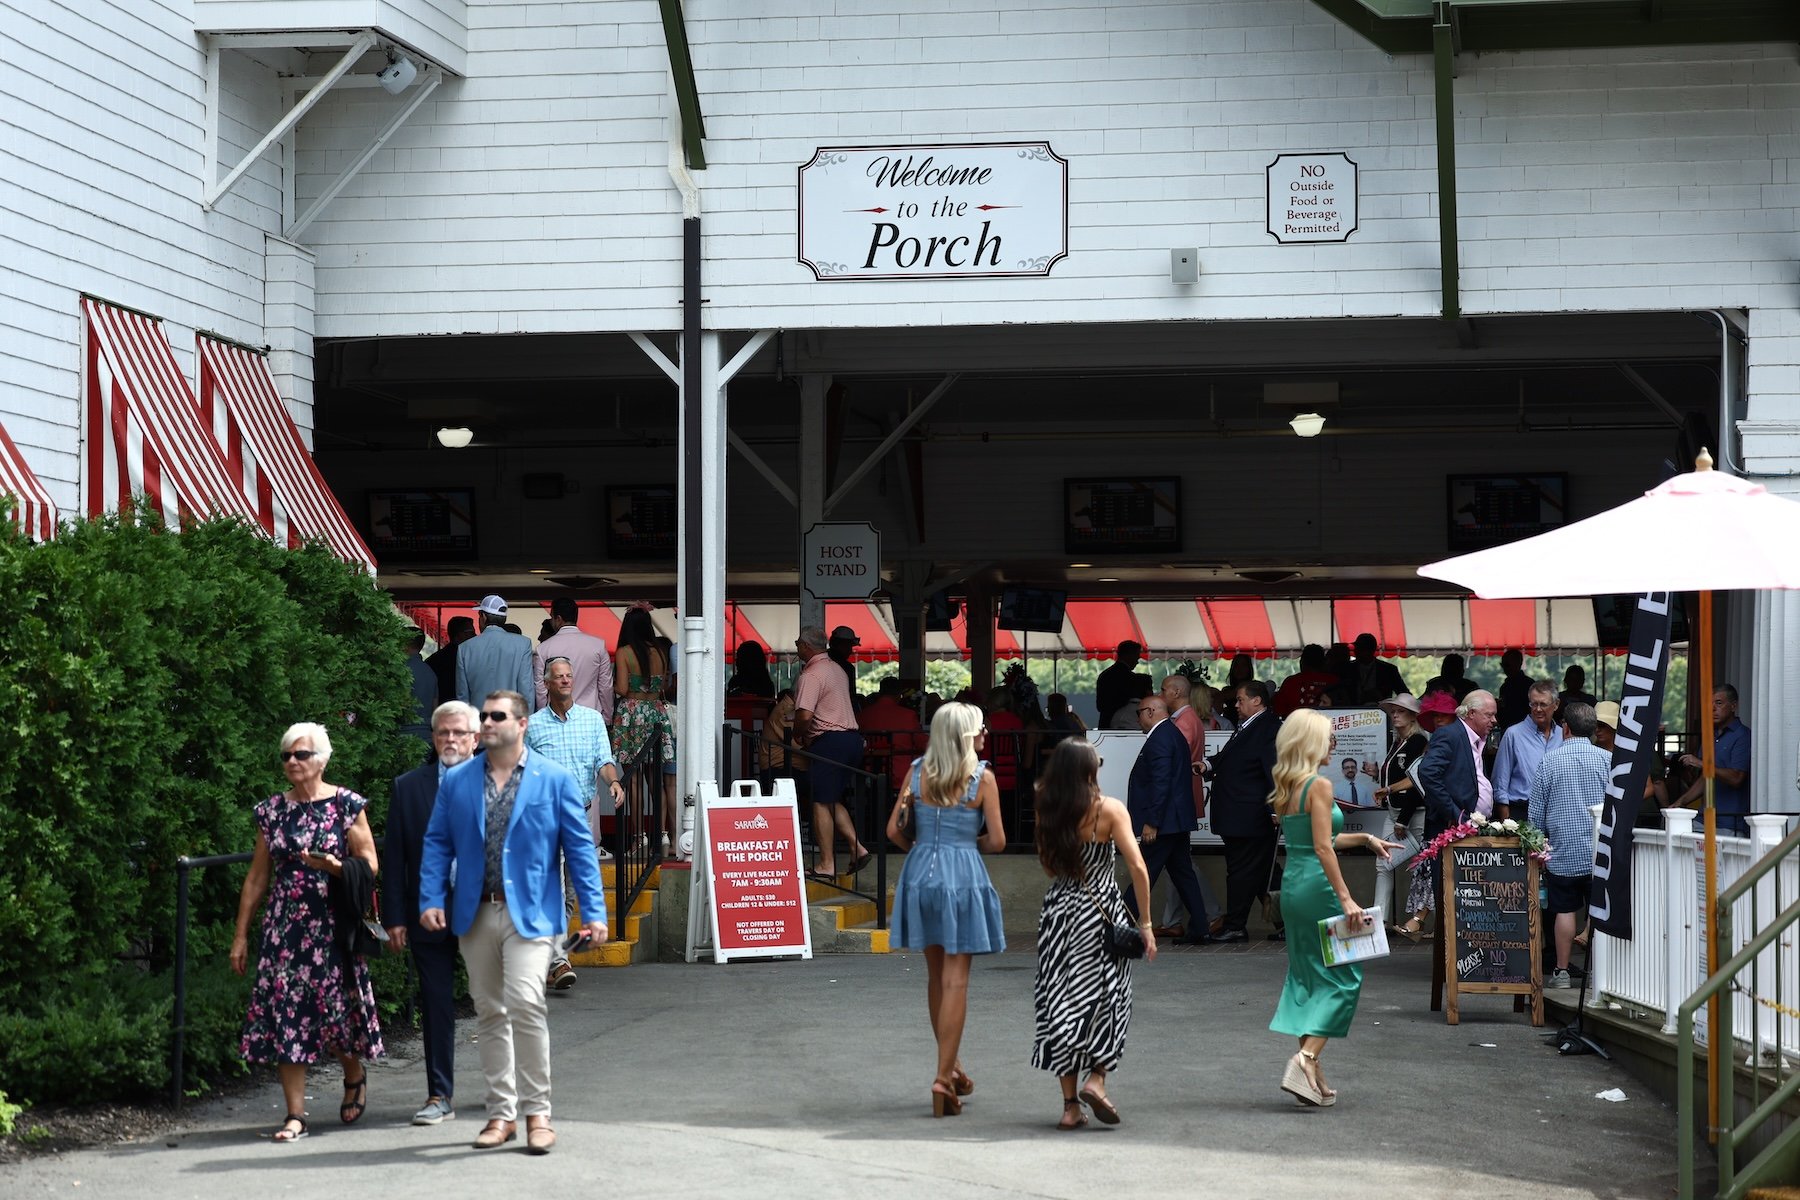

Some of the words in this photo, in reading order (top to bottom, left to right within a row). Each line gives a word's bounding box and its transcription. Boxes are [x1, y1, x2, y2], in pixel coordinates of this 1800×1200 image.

[866, 155, 993, 188] Welcome
[1300, 165, 1325, 177] NO
[1290, 180, 1334, 191] Outside
[1290, 195, 1317, 206] Food
[897, 199, 919, 218] to
[931, 196, 968, 217] the
[1287, 210, 1337, 221] Beverage
[1285, 222, 1340, 234] Permitted
[860, 221, 1002, 269] Porch
[820, 546, 863, 559] HOST
[816, 564, 867, 576] STAND
[1338, 711, 1380, 723] BETTING
[1352, 718, 1382, 728] SHOW
[717, 841, 774, 852] BREAKFAST
[776, 840, 789, 850] AT
[726, 853, 746, 863] THE
[747, 852, 782, 862] PORCH
[1453, 850, 1504, 867] WELCOME
[1460, 867, 1485, 882] THE
[754, 878, 782, 886] 9:30AM
[1478, 881, 1525, 898] TRAVERS
[1489, 950, 1508, 963] NO
